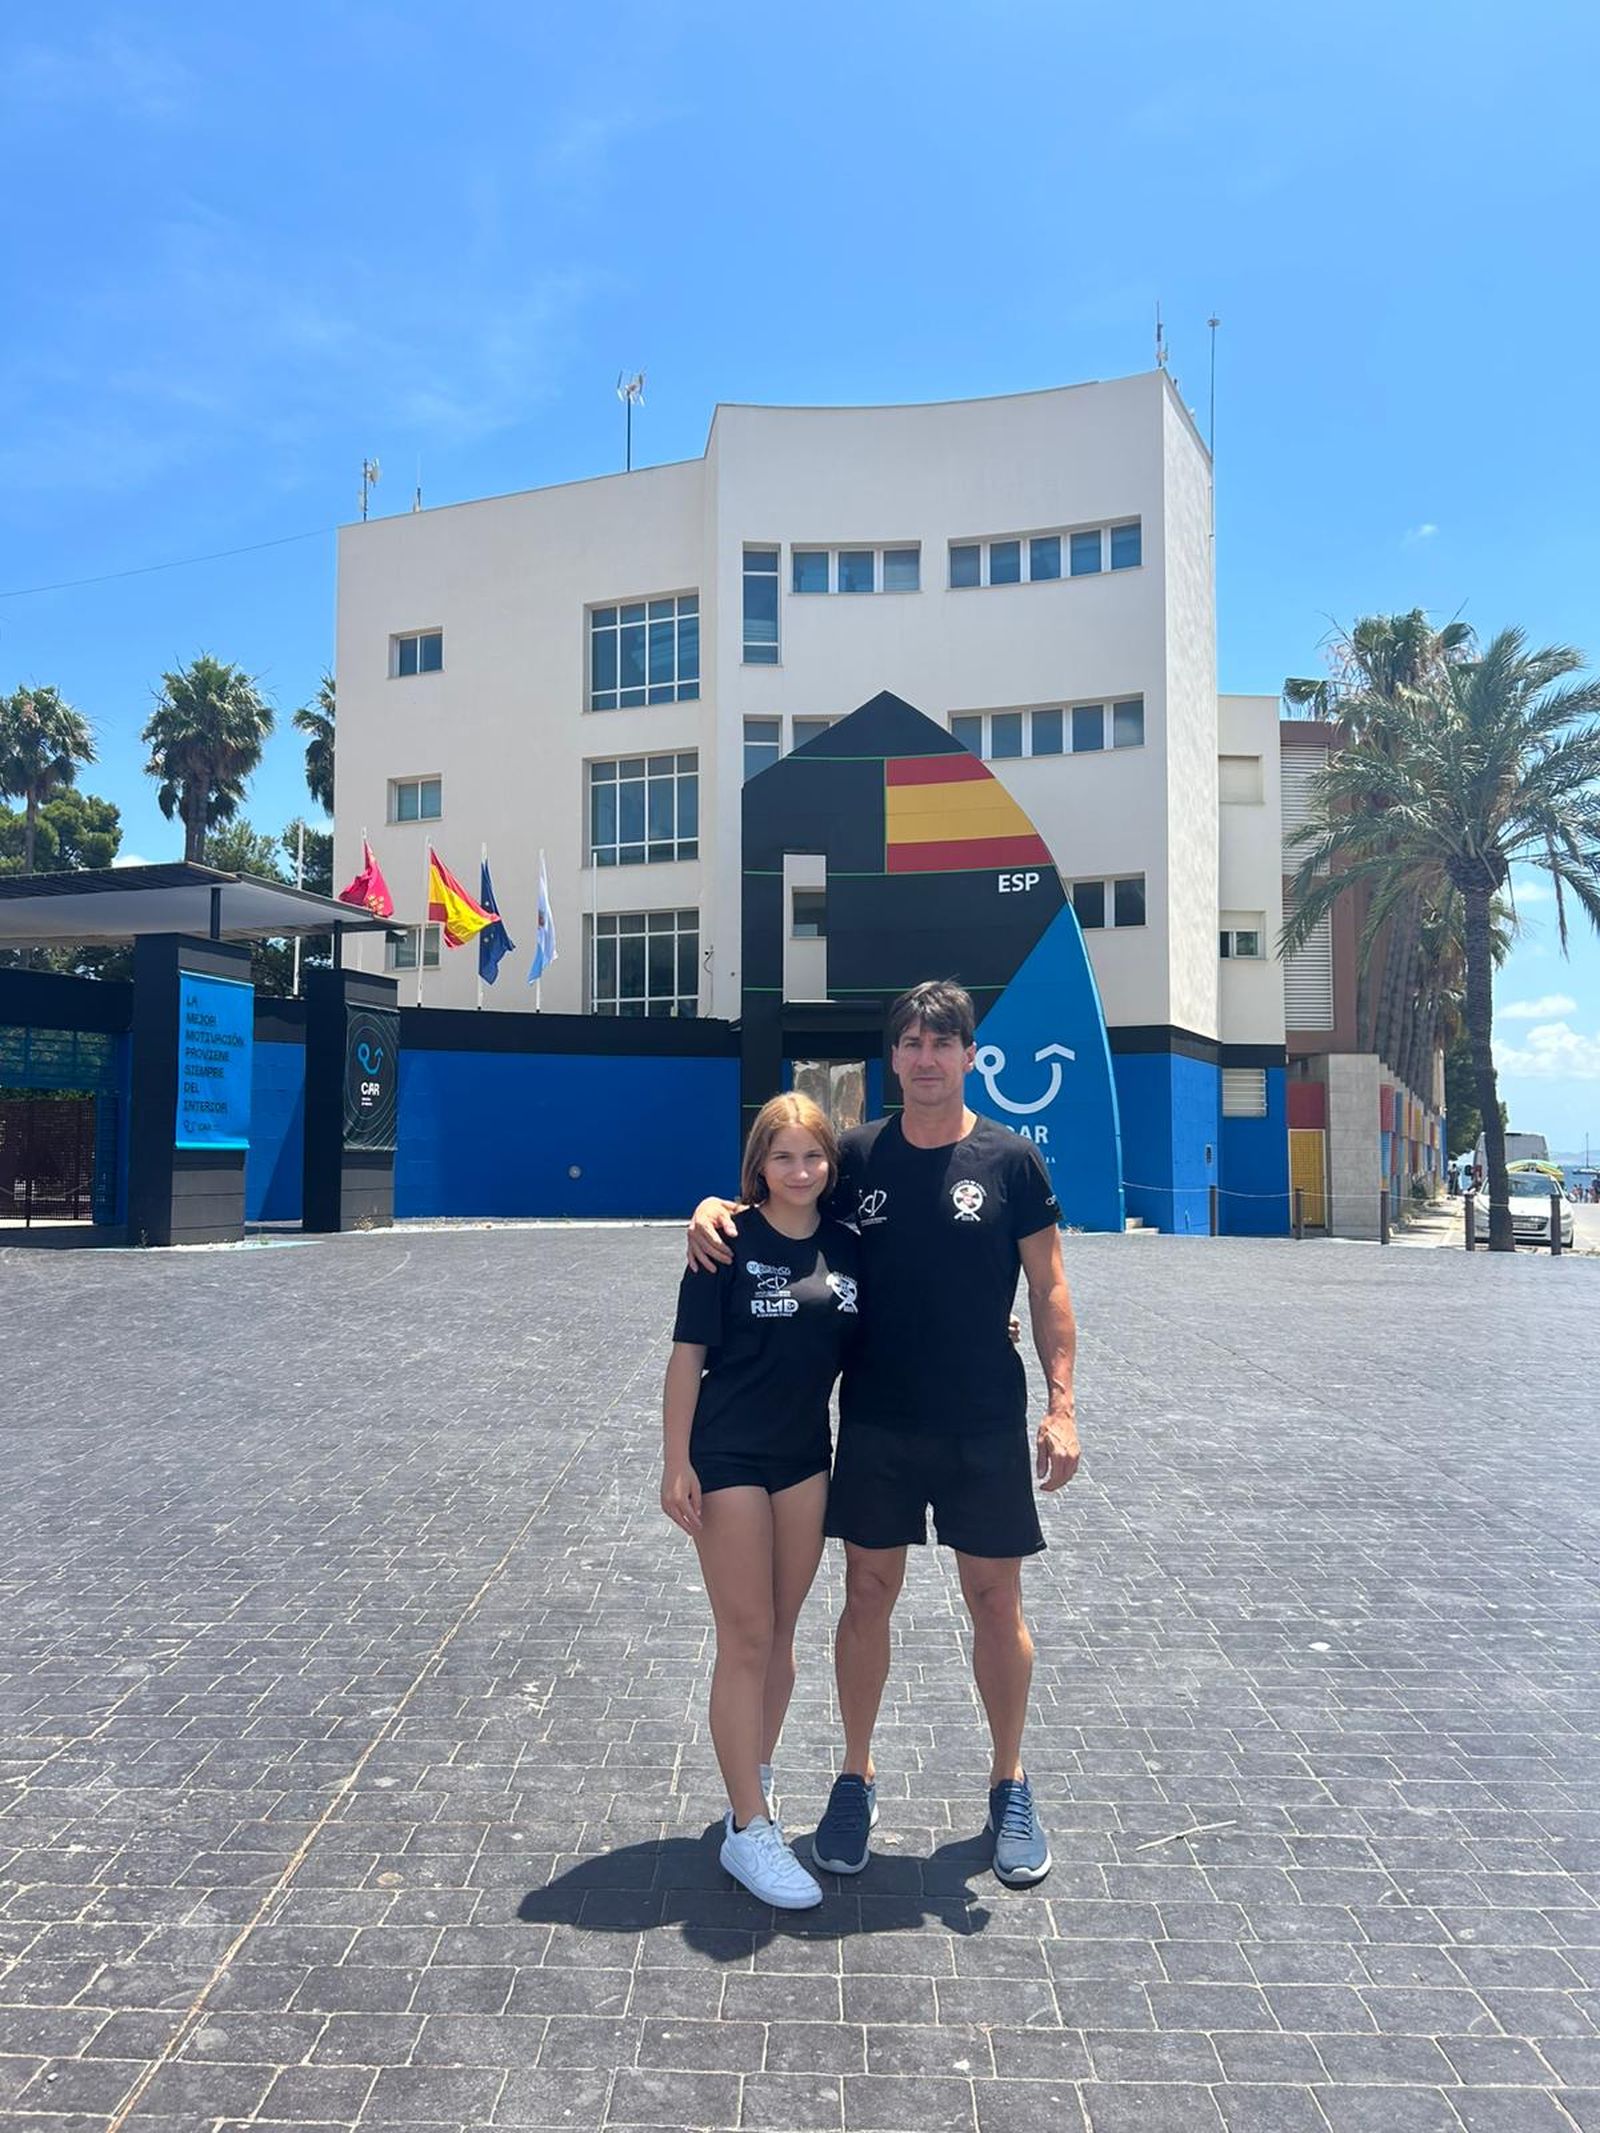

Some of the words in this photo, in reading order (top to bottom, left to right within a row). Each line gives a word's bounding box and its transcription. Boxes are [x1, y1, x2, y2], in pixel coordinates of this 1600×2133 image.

[998, 872, 1040, 893] ESP
[186, 996, 198, 1008] LA
[186, 1012, 216, 1027] MEJOR
[185, 1047, 229, 1062] PROVIENE
[184, 1065, 225, 1079] SIEMPRE
[184, 1082, 199, 1093] DEL
[361, 1082, 380, 1096] CAR
[184, 1100, 228, 1114] INTERIOR
[1005, 1124, 1049, 1144] AR
